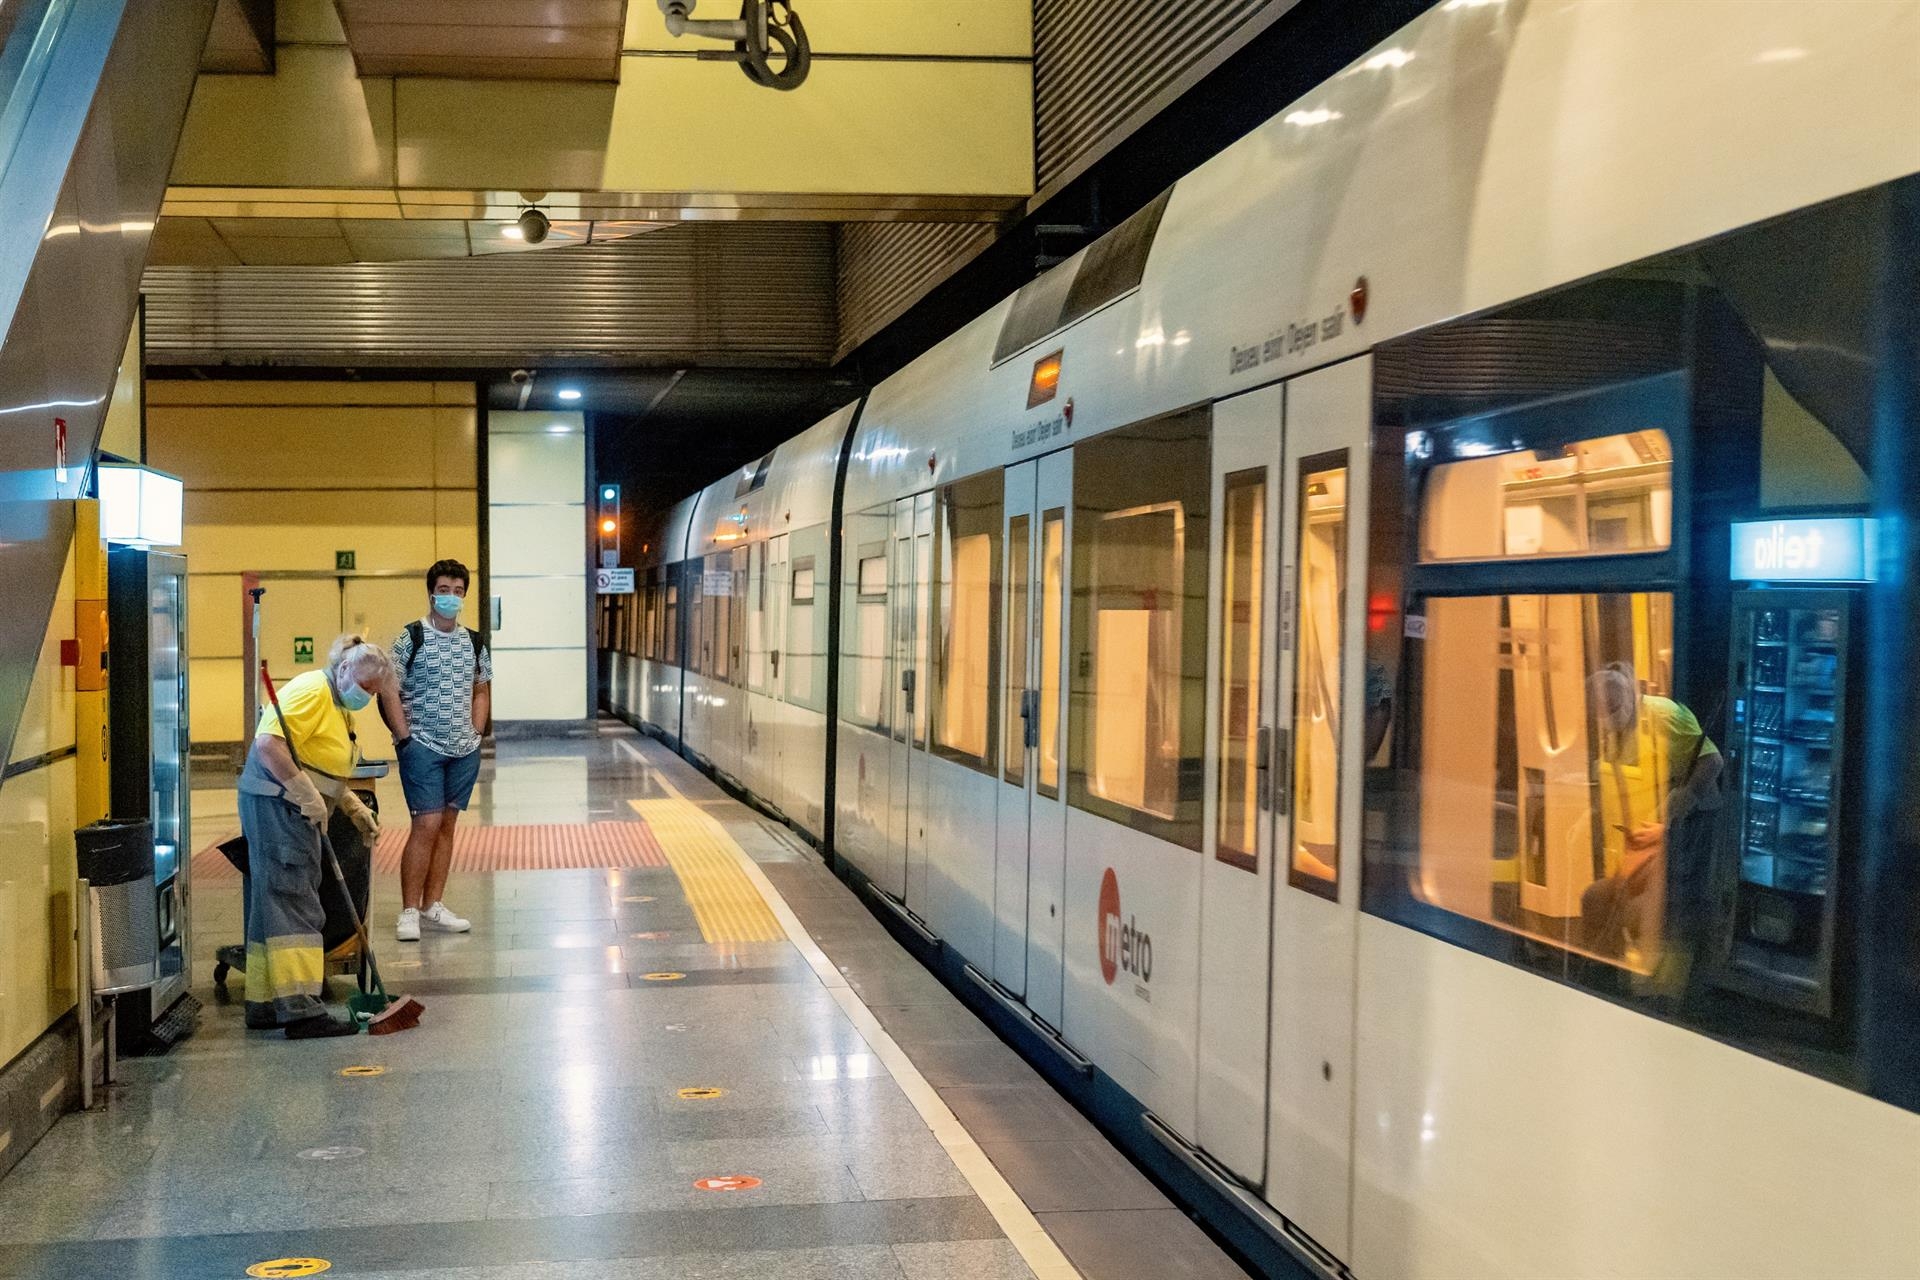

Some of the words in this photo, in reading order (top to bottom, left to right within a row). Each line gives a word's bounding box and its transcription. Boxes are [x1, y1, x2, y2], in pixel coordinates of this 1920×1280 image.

[1288, 319, 1318, 357] Dejen
[1321, 305, 1345, 342] salir
[1103, 910, 1153, 984] metro
